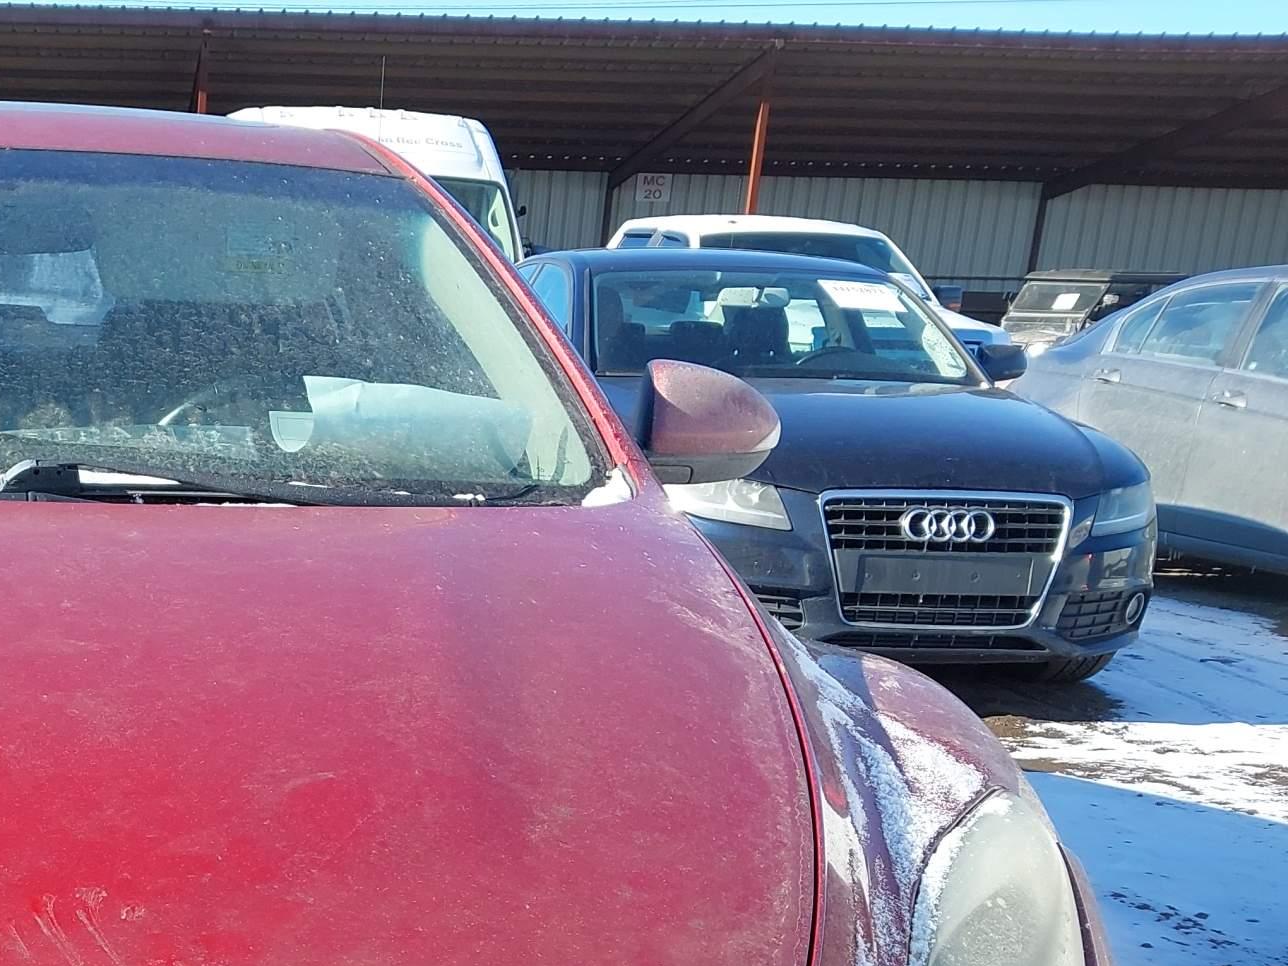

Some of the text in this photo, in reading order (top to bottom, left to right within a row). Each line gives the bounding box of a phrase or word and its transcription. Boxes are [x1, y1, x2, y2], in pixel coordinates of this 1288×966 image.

[425, 137, 464, 149] Cross
[643, 175, 666, 186] MC
[643, 188, 663, 200] 20
